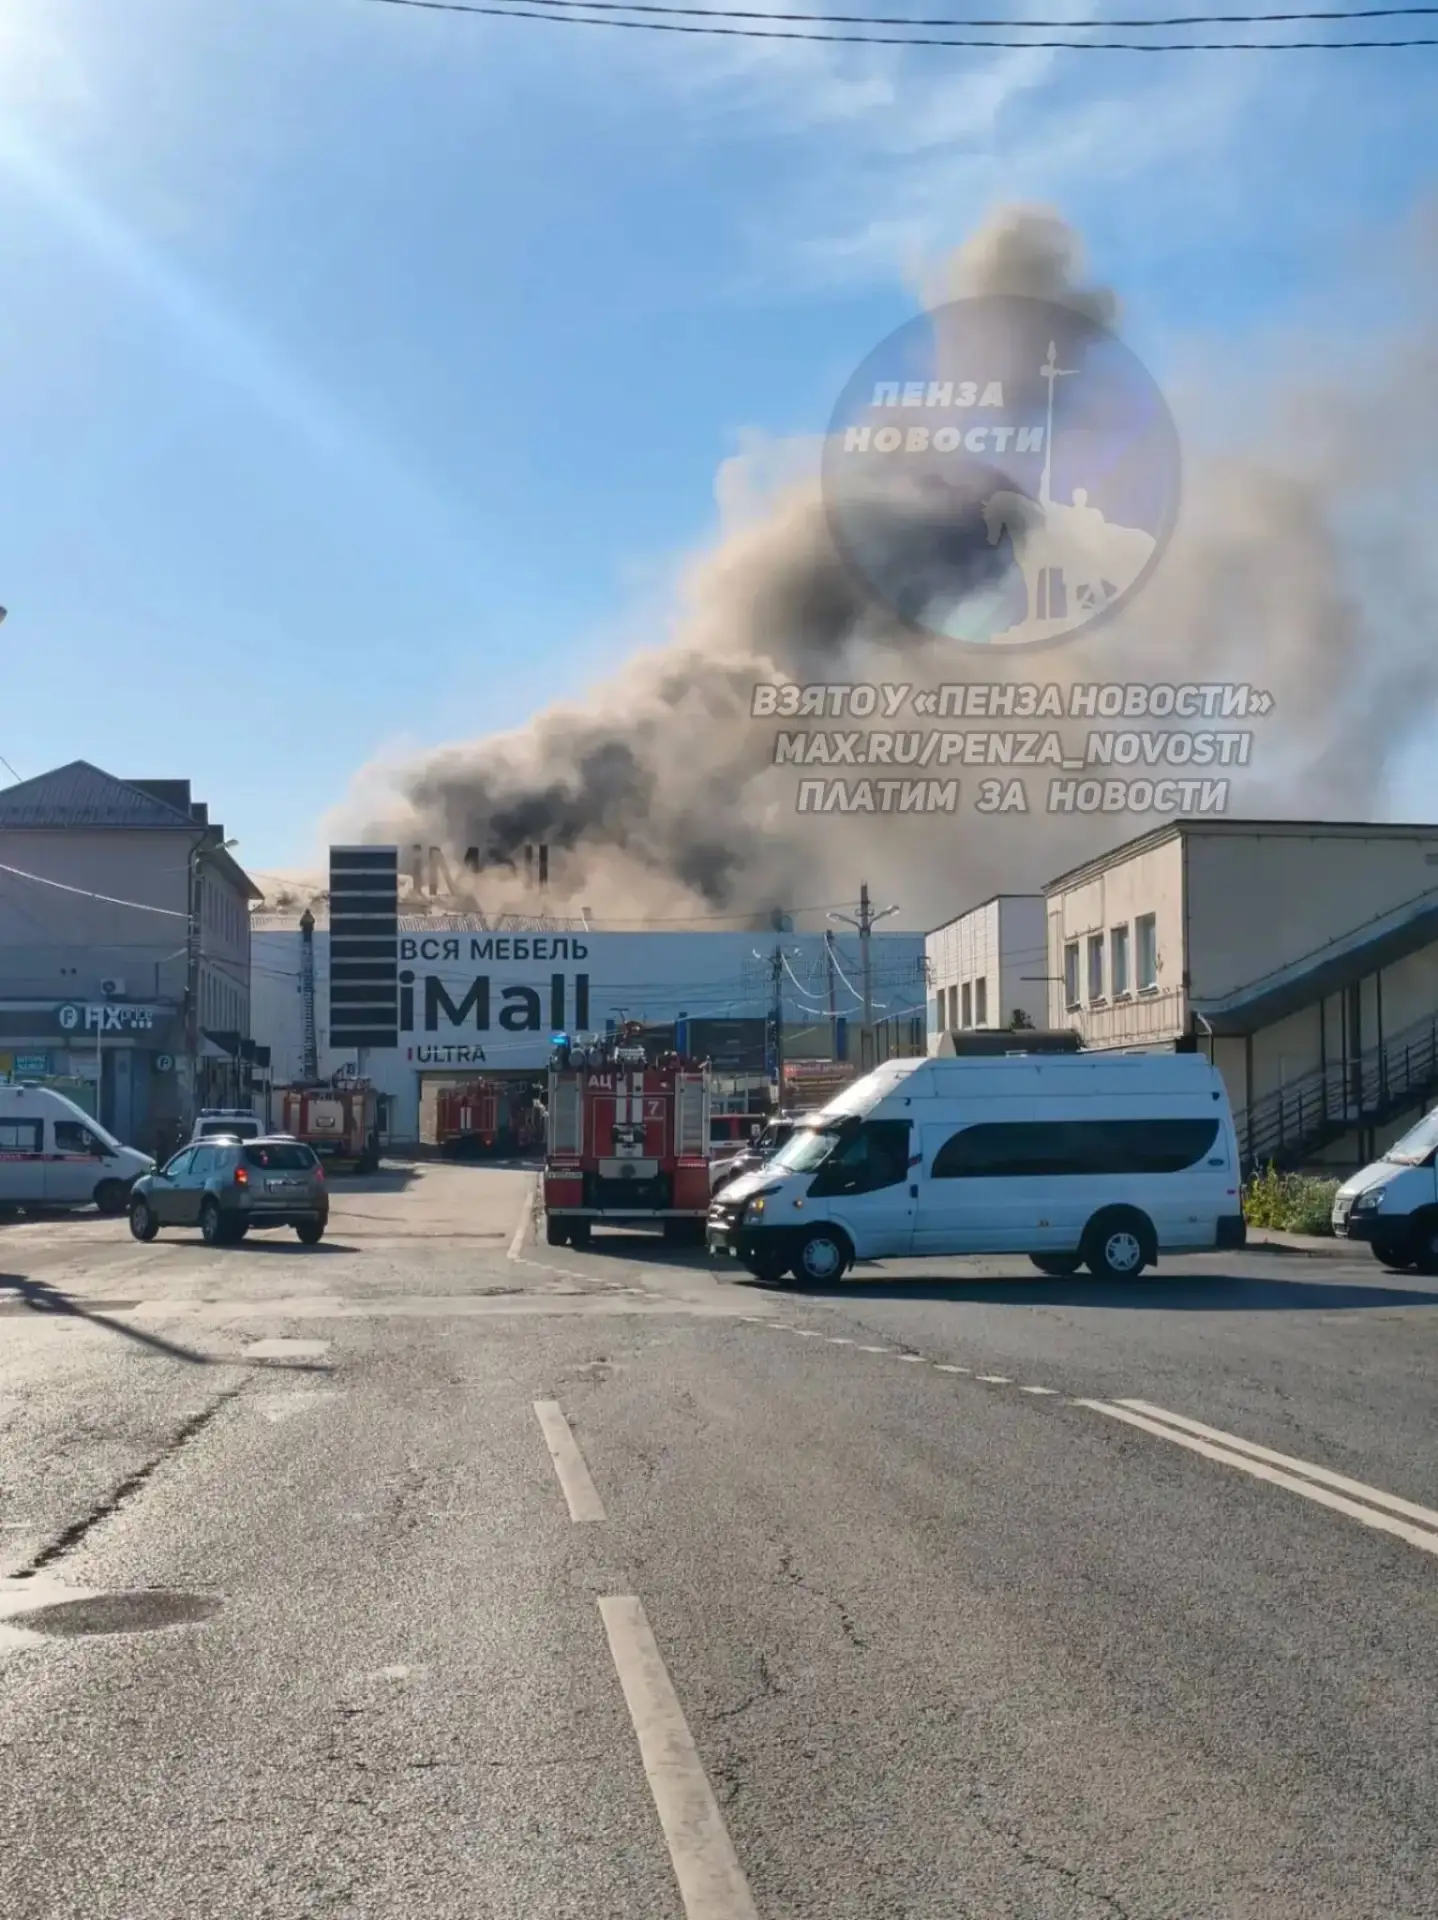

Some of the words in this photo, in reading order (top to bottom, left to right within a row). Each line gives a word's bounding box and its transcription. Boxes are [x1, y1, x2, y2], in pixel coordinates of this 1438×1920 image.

[400, 938, 459, 961] ВСЯ
[470, 938, 589, 961] МЕБЕЛЬ
[399, 970, 590, 1032] iMall
[85, 1006, 123, 1030] FIX
[416, 1045, 486, 1063] ULTRA
[588, 1074, 612, 1089] АЦ
[648, 1100, 661, 1115] 7
